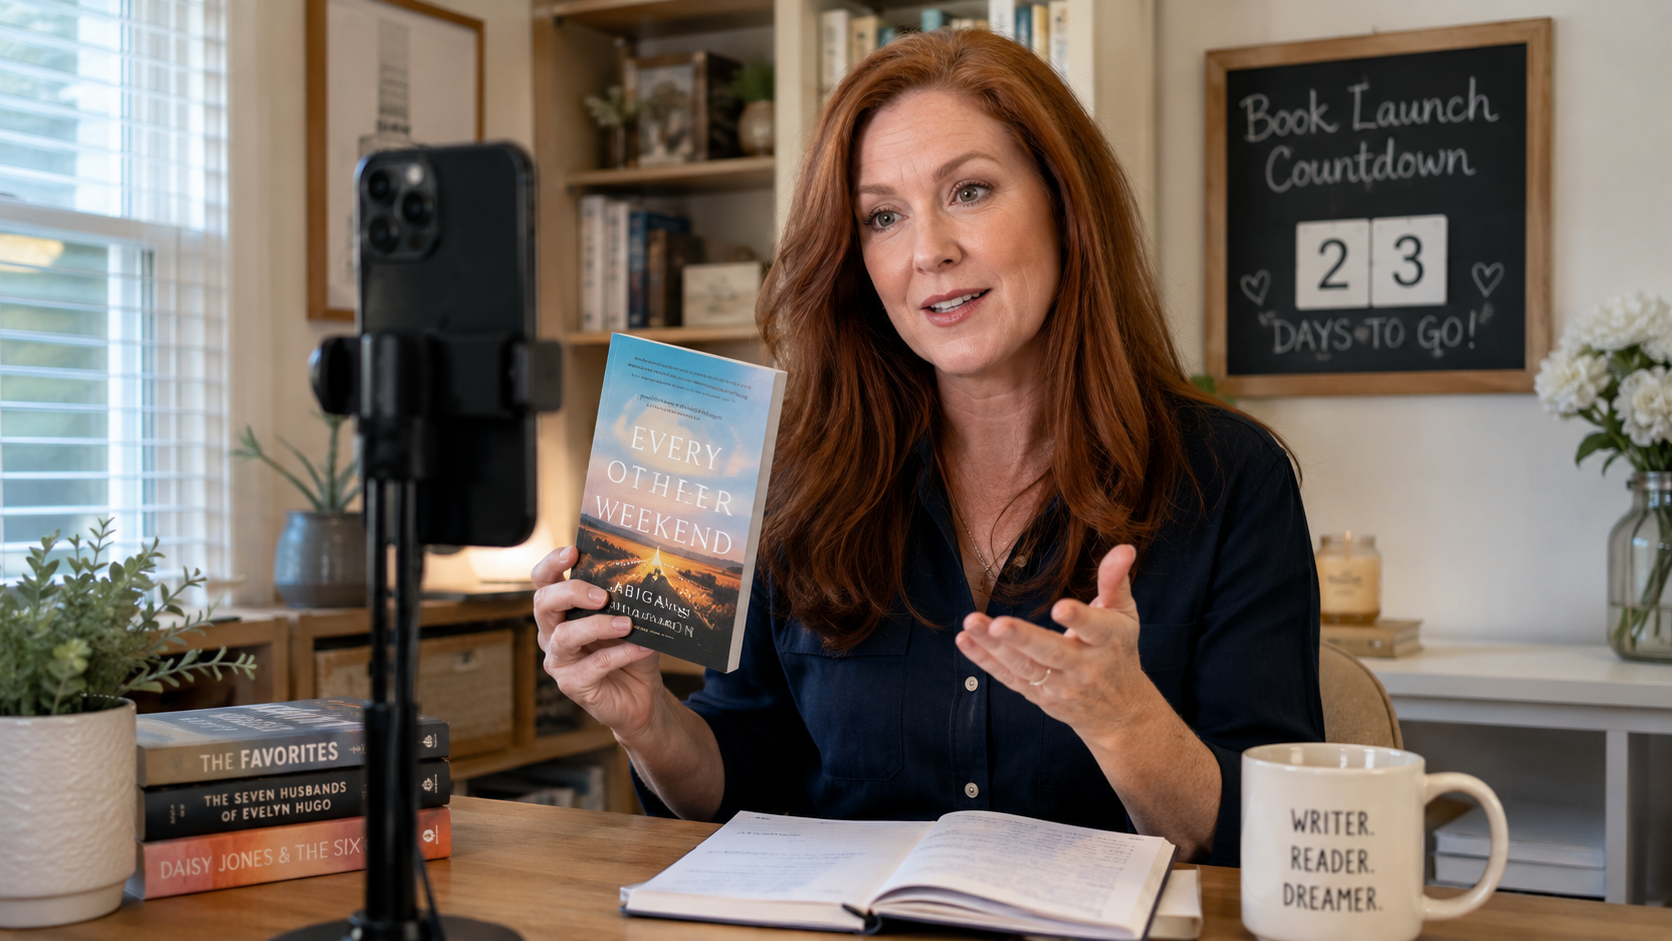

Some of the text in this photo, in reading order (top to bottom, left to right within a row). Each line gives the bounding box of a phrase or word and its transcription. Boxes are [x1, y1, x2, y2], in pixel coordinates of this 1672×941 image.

[1240, 76, 1500, 142] Book Launch
[1265, 137, 1477, 193] Countdown
[1317, 235, 1425, 291] 2 3
[1273, 310, 1477, 356] DAYS TO GO!
[631, 425, 722, 470] EVERY
[595, 495, 732, 555] WEEKEND
[200, 752, 234, 773] THE
[240, 741, 339, 770] FAVORITES
[204, 793, 229, 807] THE
[234, 789, 275, 805] SEVEN
[280, 781, 347, 799] HUSBANDS
[221, 799, 332, 822] OF EVELYN HUGO
[1290, 809, 1376, 836] WRITER.
[160, 837, 361, 879] DAISY JONES & THE SIX
[1291, 846, 1376, 874] READER.
[1283, 883, 1384, 912] DREAMER.
